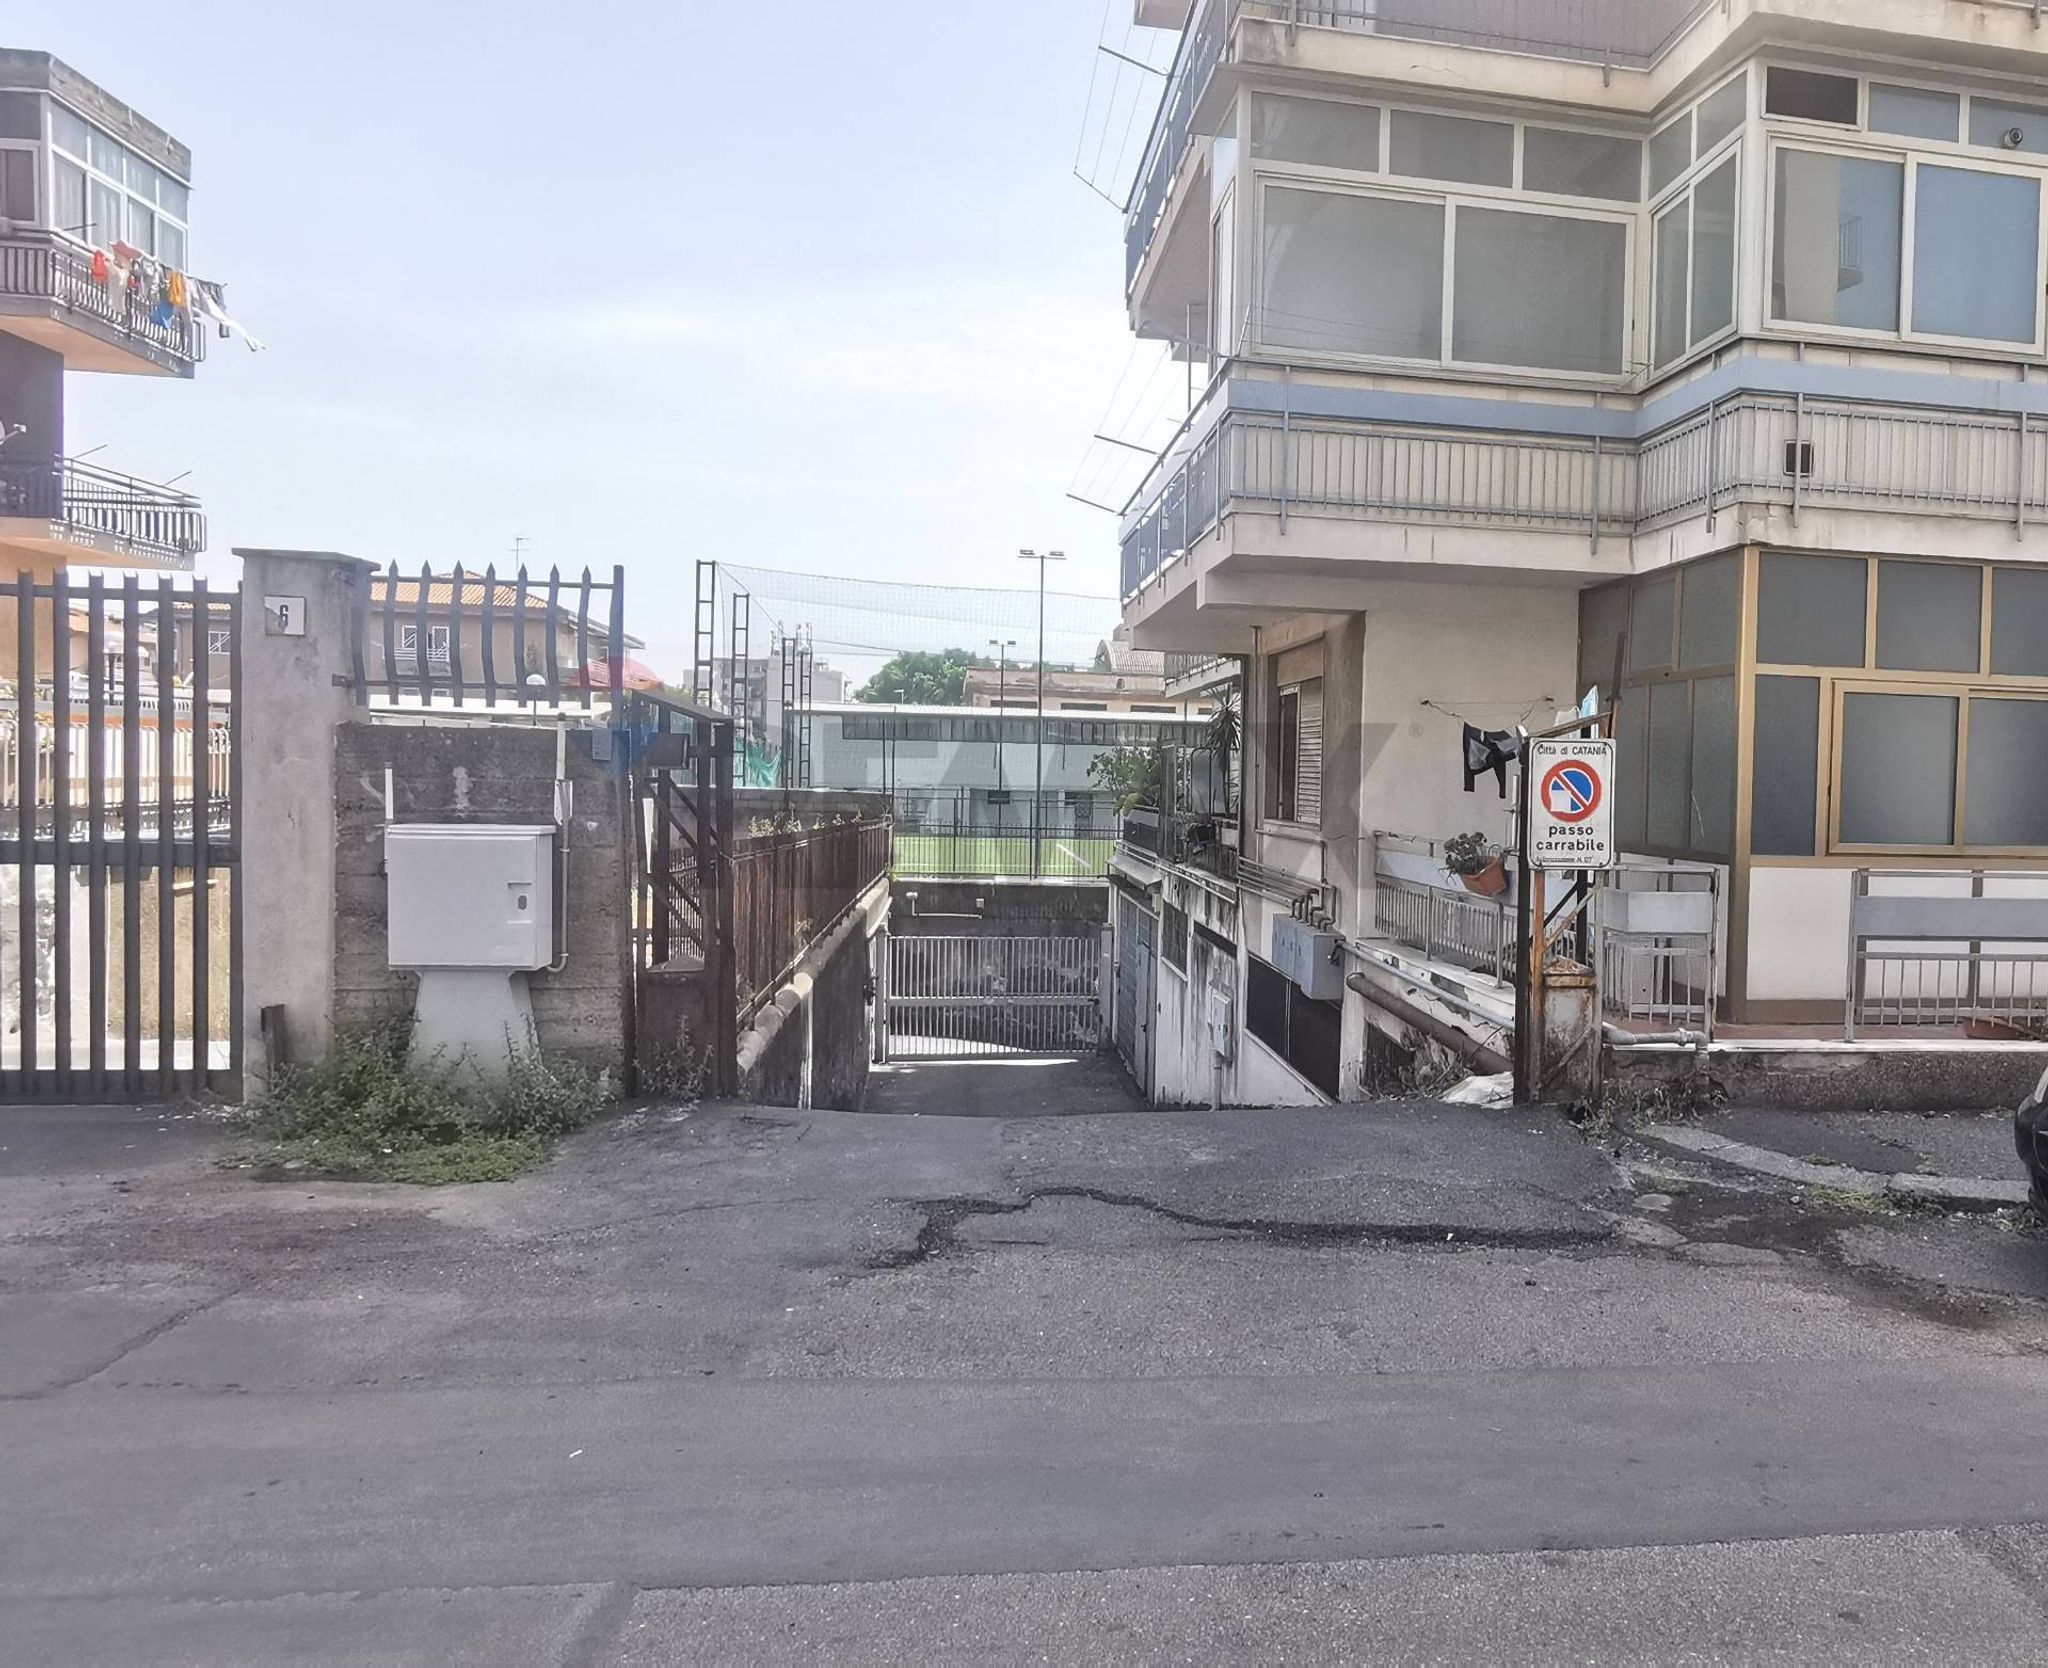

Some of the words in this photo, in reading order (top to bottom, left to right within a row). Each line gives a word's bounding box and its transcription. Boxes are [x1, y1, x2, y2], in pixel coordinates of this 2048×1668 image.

[1537, 746, 1556, 755] Città
[1560, 746, 1568, 755] di
[1572, 746, 1607, 755] CATANIA
[1549, 826, 1594, 837] passo
[1536, 839, 1604, 851] carrabile
